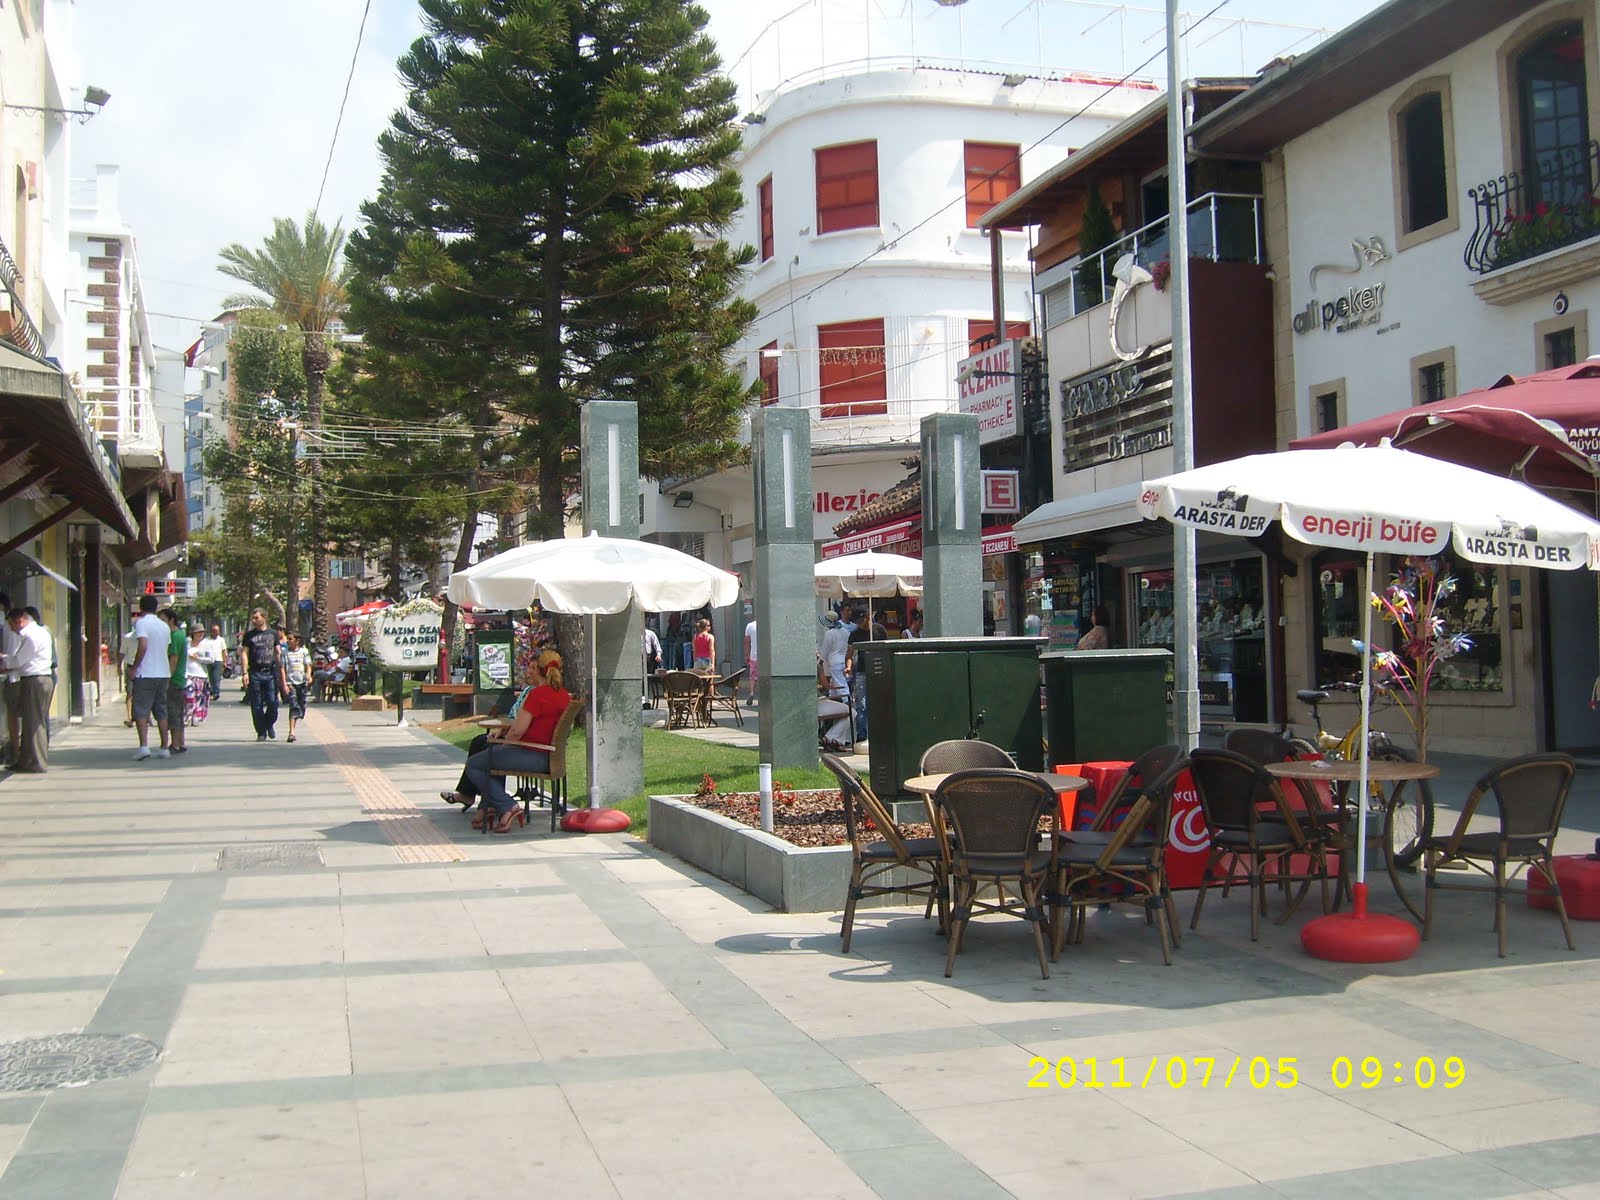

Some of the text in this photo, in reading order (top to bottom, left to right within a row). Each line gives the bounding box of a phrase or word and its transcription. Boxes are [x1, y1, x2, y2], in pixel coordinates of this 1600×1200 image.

[1322, 282, 1384, 331] peker
[960, 348, 1011, 399] ECZANE
[970, 395, 1004, 414] PHARMACY
[1006, 400, 1013, 418] E
[979, 414, 1005, 432] OTHEKE
[1570, 438, 1600, 450] BÜYÜ
[813, 489, 881, 513] llezi
[991, 479, 1011, 504] E
[1173, 505, 1266, 531] ARASTA DER
[1302, 515, 1437, 544] enerji büfe
[843, 541, 861, 553] ÖZMEN
[862, 534, 882, 547] DÖNER
[1466, 537, 1529, 559] ARASTA
[1534, 545, 1571, 562] DER
[384, 627, 415, 636] KAZIM
[395, 635, 437, 645] CADDESİ
